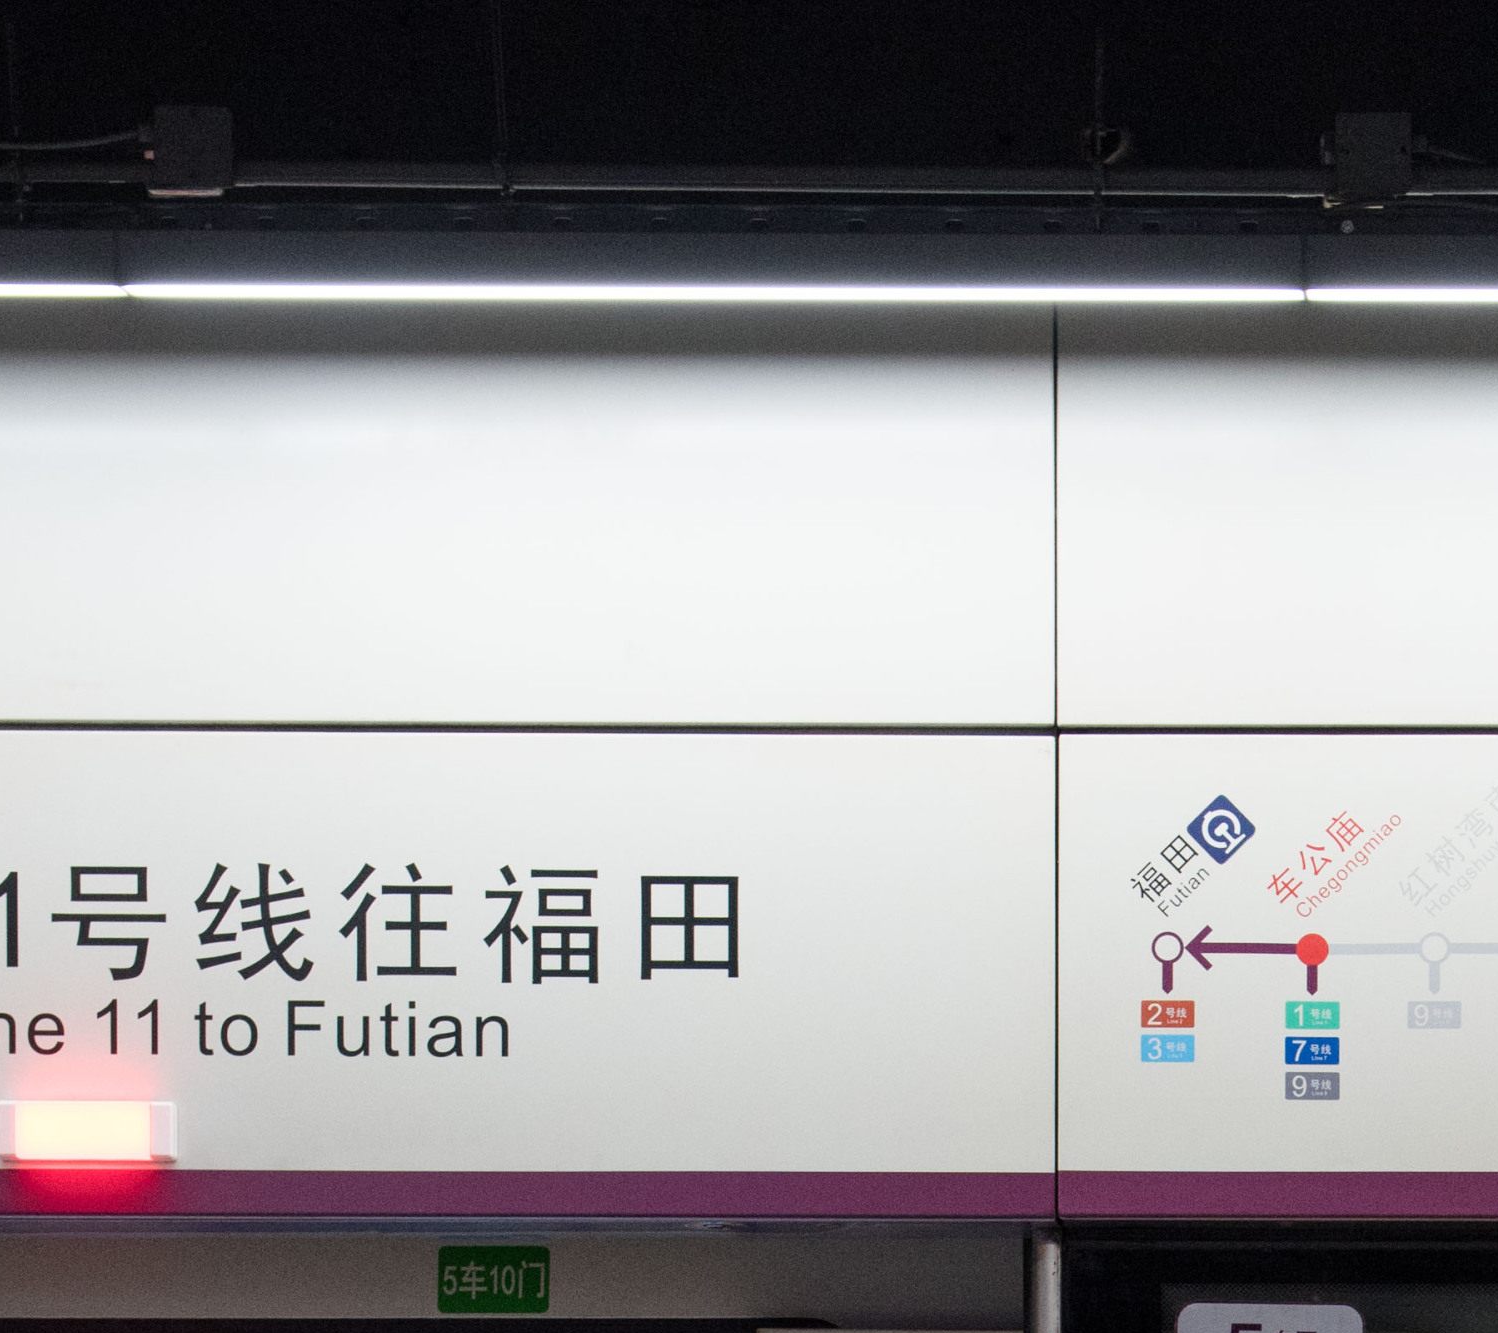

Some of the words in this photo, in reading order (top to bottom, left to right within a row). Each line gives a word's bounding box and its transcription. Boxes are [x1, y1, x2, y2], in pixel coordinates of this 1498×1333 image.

[1129, 834, 1200, 903] 福田
[1266, 809, 1366, 905] 车公庙
[1295, 812, 1402, 919] Chegongmiao
[1157, 865, 1211, 918] Futian
[97, 998, 159, 1056] 11
[194, 1000, 260, 1057] to
[287, 1000, 510, 1058] Futian
[1292, 1039, 1333, 1062] 7号线
[442, 1260, 545, 1301] 5车10门
